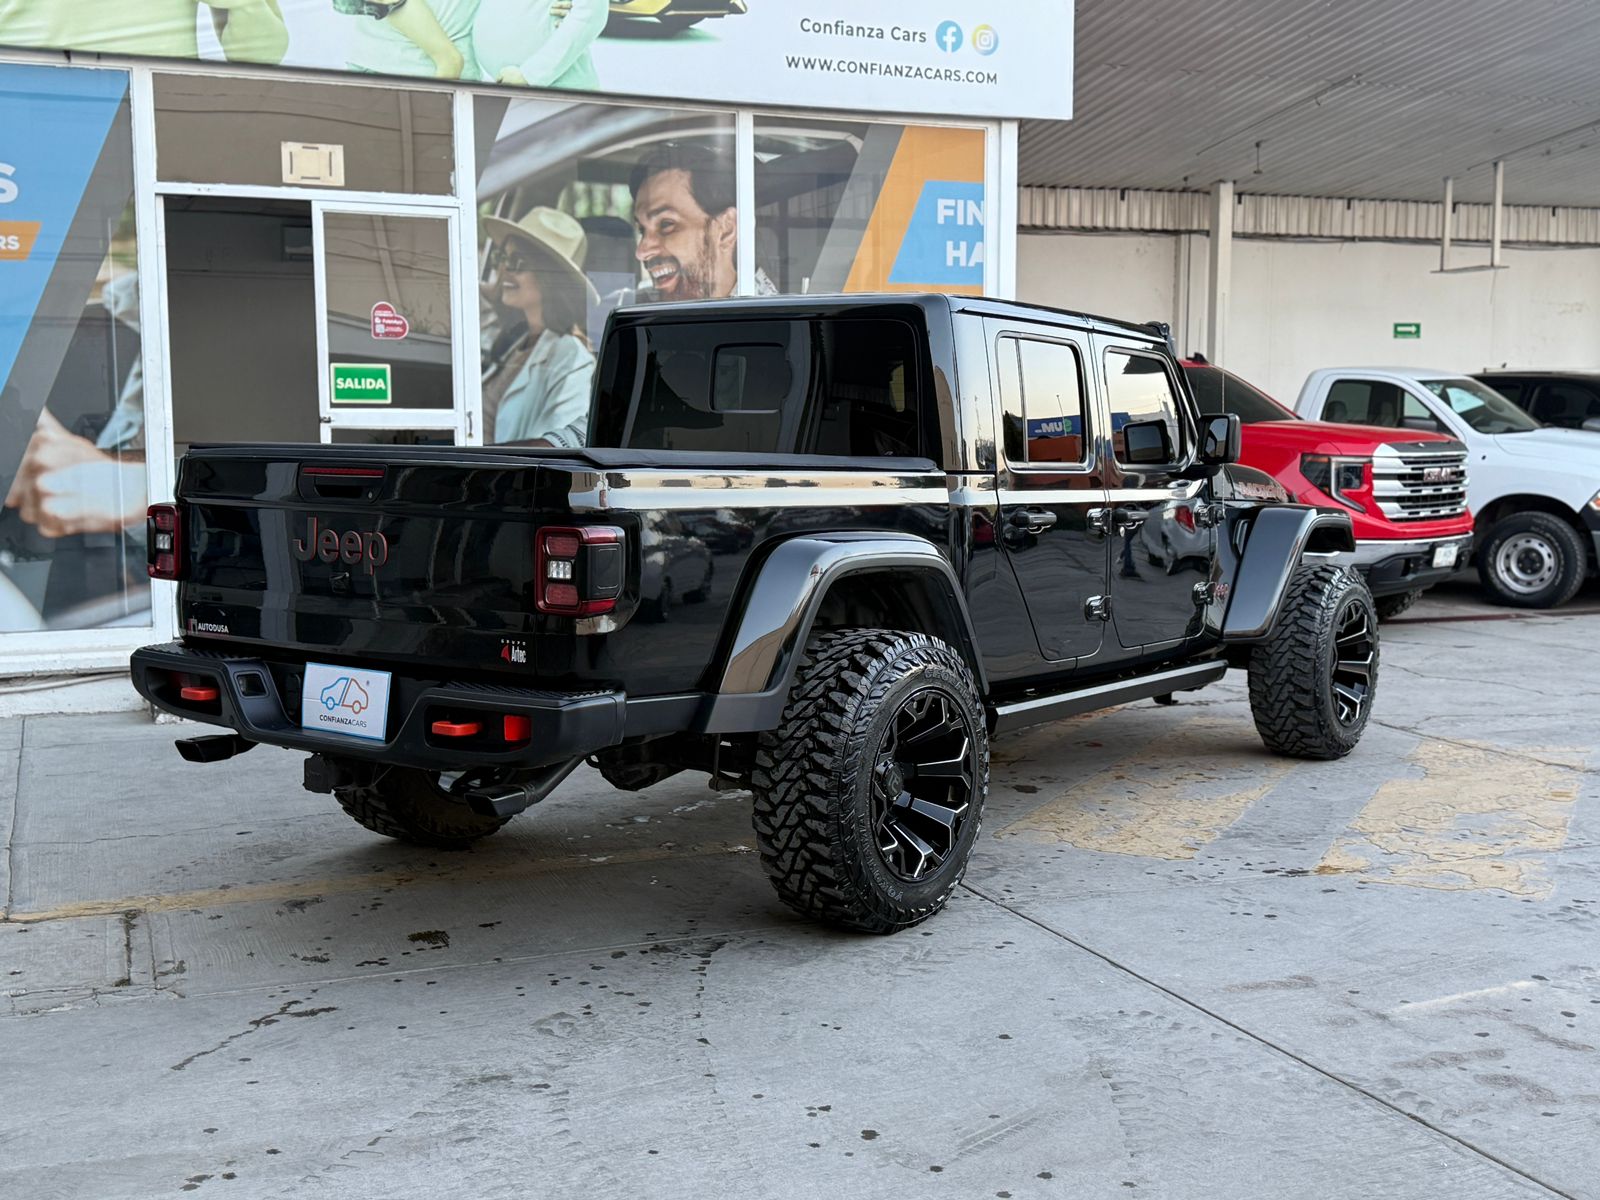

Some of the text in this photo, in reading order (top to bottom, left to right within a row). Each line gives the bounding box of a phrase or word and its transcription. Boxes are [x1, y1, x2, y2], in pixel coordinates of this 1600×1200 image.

[799, 18, 927, 43] Confianza Cars
[785, 55, 998, 85] WWW.CONFIANZACARS.COM
[937, 198, 984, 226] FIN
[946, 240, 984, 267] HA
[336, 377, 386, 390] SALIDA
[293, 516, 388, 576] Jeep
[319, 714, 367, 728] CONFIANZACARS
